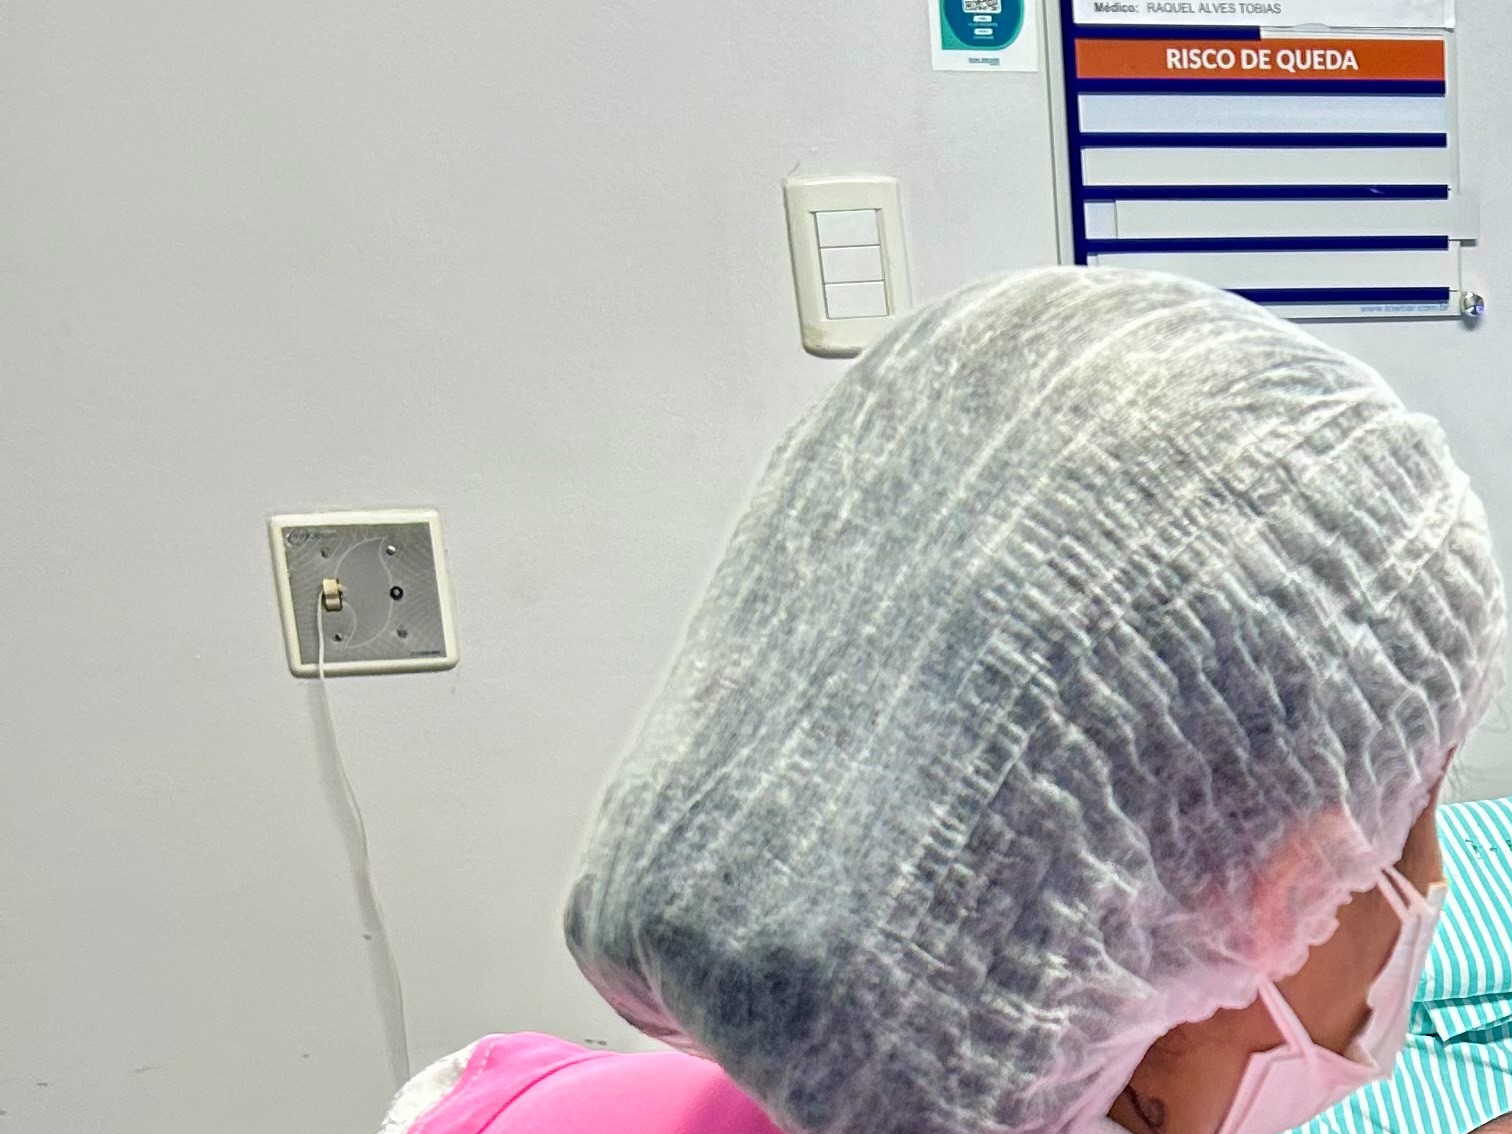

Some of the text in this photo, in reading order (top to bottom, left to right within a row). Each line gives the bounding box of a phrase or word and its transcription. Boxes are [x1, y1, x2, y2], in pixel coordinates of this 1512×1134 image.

[1147, 2, 1195, 14] RAQUEL
[1198, 2, 1236, 14] ALVES
[1240, 3, 1281, 14] TOBIAS
[1166, 48, 1359, 73] RISCO DE QUEDA
